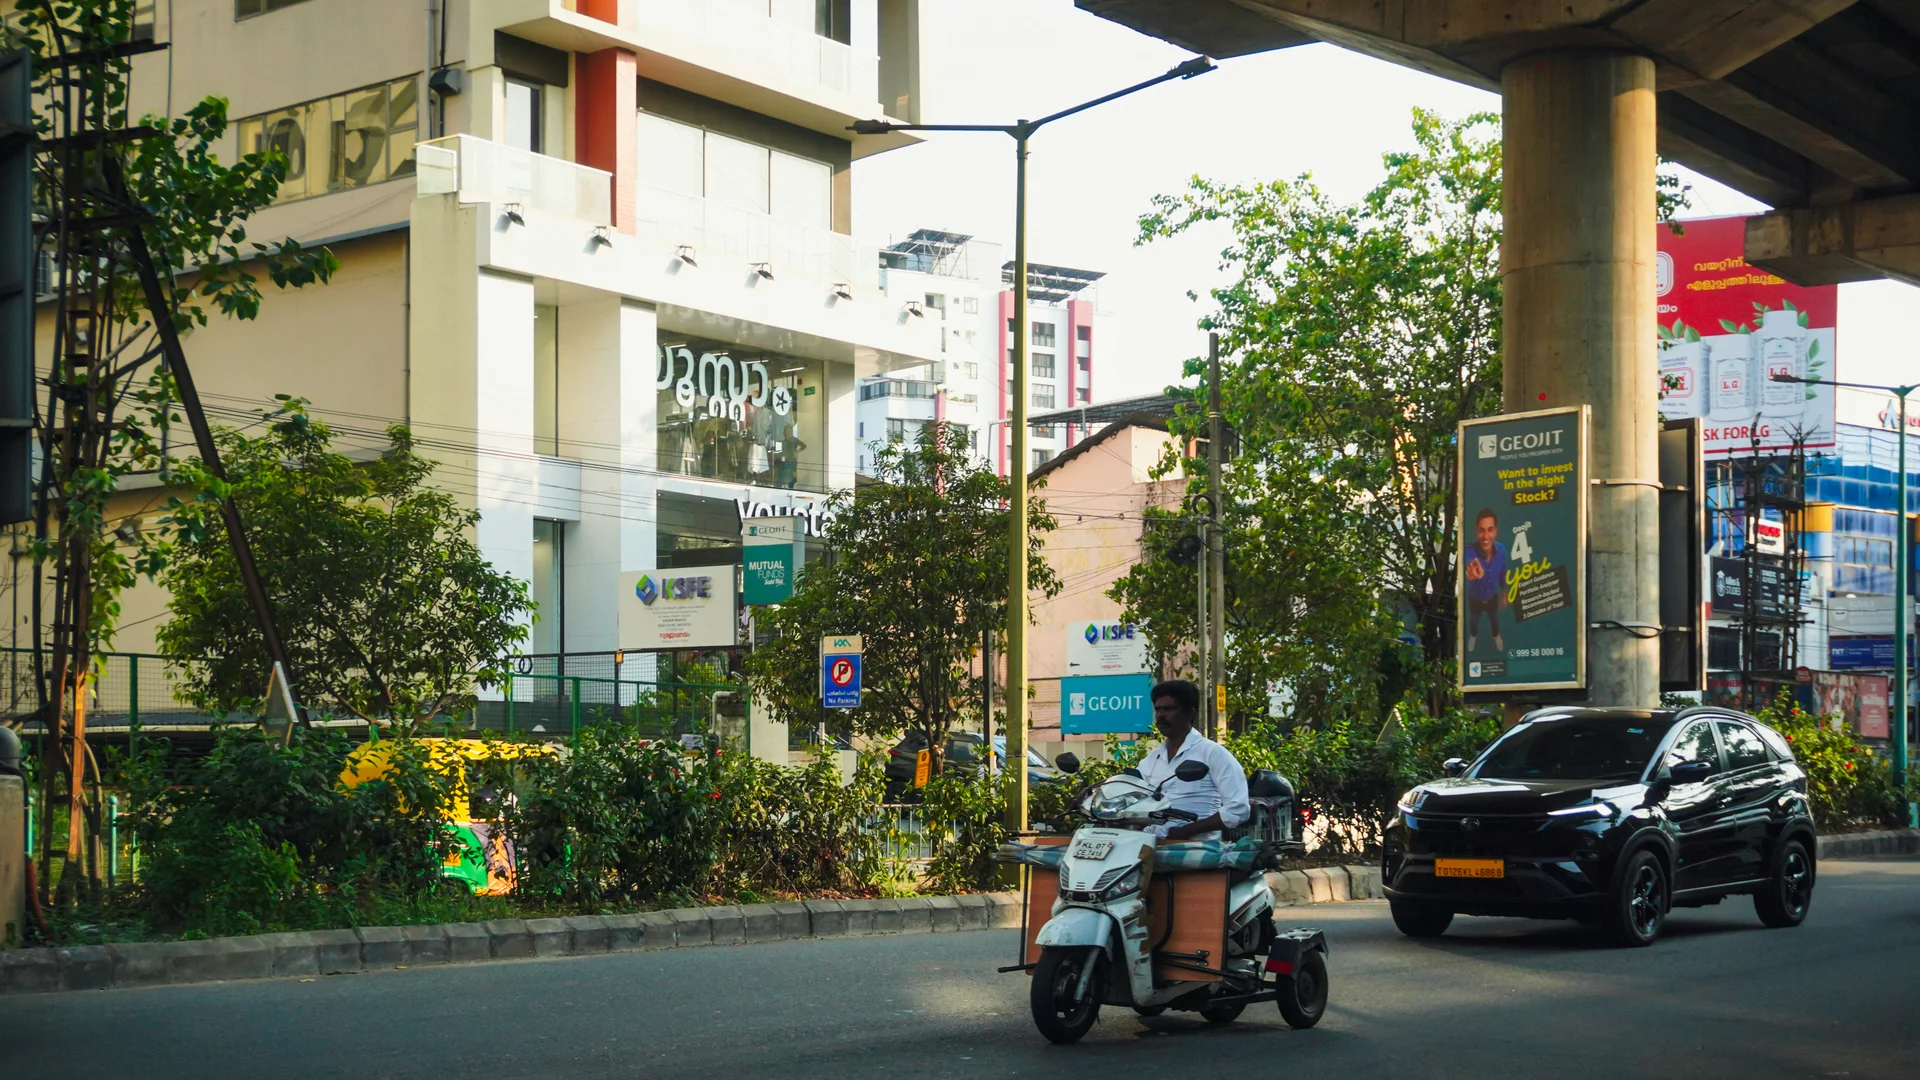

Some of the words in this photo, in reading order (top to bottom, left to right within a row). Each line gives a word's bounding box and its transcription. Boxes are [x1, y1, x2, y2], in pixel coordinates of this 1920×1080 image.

[1500, 429, 1563, 452] GEOJIT
[1703, 428, 1719, 441] SK
[1724, 426, 1750, 439] FOR
[1754, 425, 1770, 438] LG
[1497, 468, 1526, 479] Want
[1528, 466, 1539, 475] to
[1541, 462, 1573, 474] invest
[1504, 480, 1514, 490] in
[1516, 478, 1535, 488] the
[1536, 475, 1565, 487] Right
[1515, 489, 1555, 504] Stock?
[758, 526, 786, 535] GEOJIT
[1512, 521, 1532, 534] Geojit
[1511, 531, 1533, 564] 4
[748, 560, 785, 571] MUTUAL
[757, 569, 785, 579] FUNDS
[1505, 557, 1552, 603] you
[1533, 571, 1555, 582] Guidance
[661, 575, 712, 600] KSFE
[1519, 586, 1539, 596] Portfolio
[1521, 587, 1560, 604] Research-backed
[1522, 593, 1564, 610] Recommendations
[1526, 608, 1547, 618] Decades
[1552, 601, 1565, 609] Trust
[1102, 624, 1136, 641] KSFE
[1516, 649, 1530, 657] 999
[1531, 649, 1540, 657] 58
[1541, 648, 1555, 656] 000
[837, 697, 857, 705] Parking
[1088, 695, 1143, 711] GEOJIT
